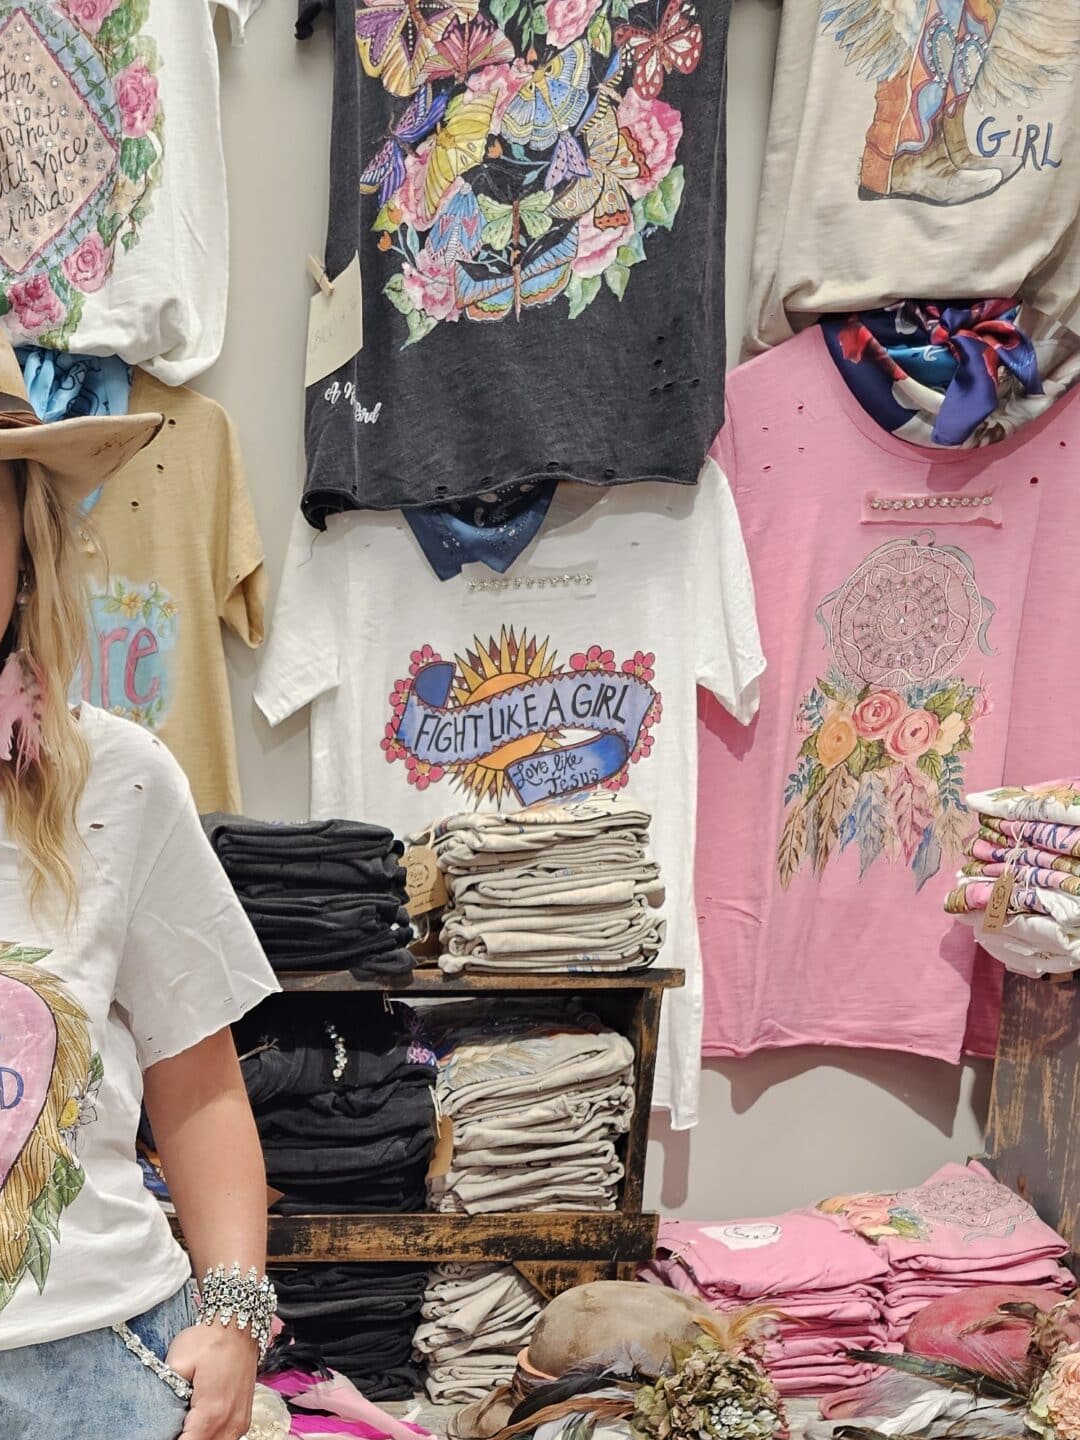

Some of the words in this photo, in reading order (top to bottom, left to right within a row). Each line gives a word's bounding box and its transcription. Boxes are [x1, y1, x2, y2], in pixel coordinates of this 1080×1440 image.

[30, 137, 88, 177] voice
[8, 176, 74, 239] inside
[413, 714, 484, 753] FIGHT
[489, 693, 539, 742] LIKE
[542, 688, 567, 727] A
[571, 683, 628, 724] GIRL
[512, 759, 550, 788] Love
[553, 750, 583, 776] like
[544, 768, 600, 795] Jesus
